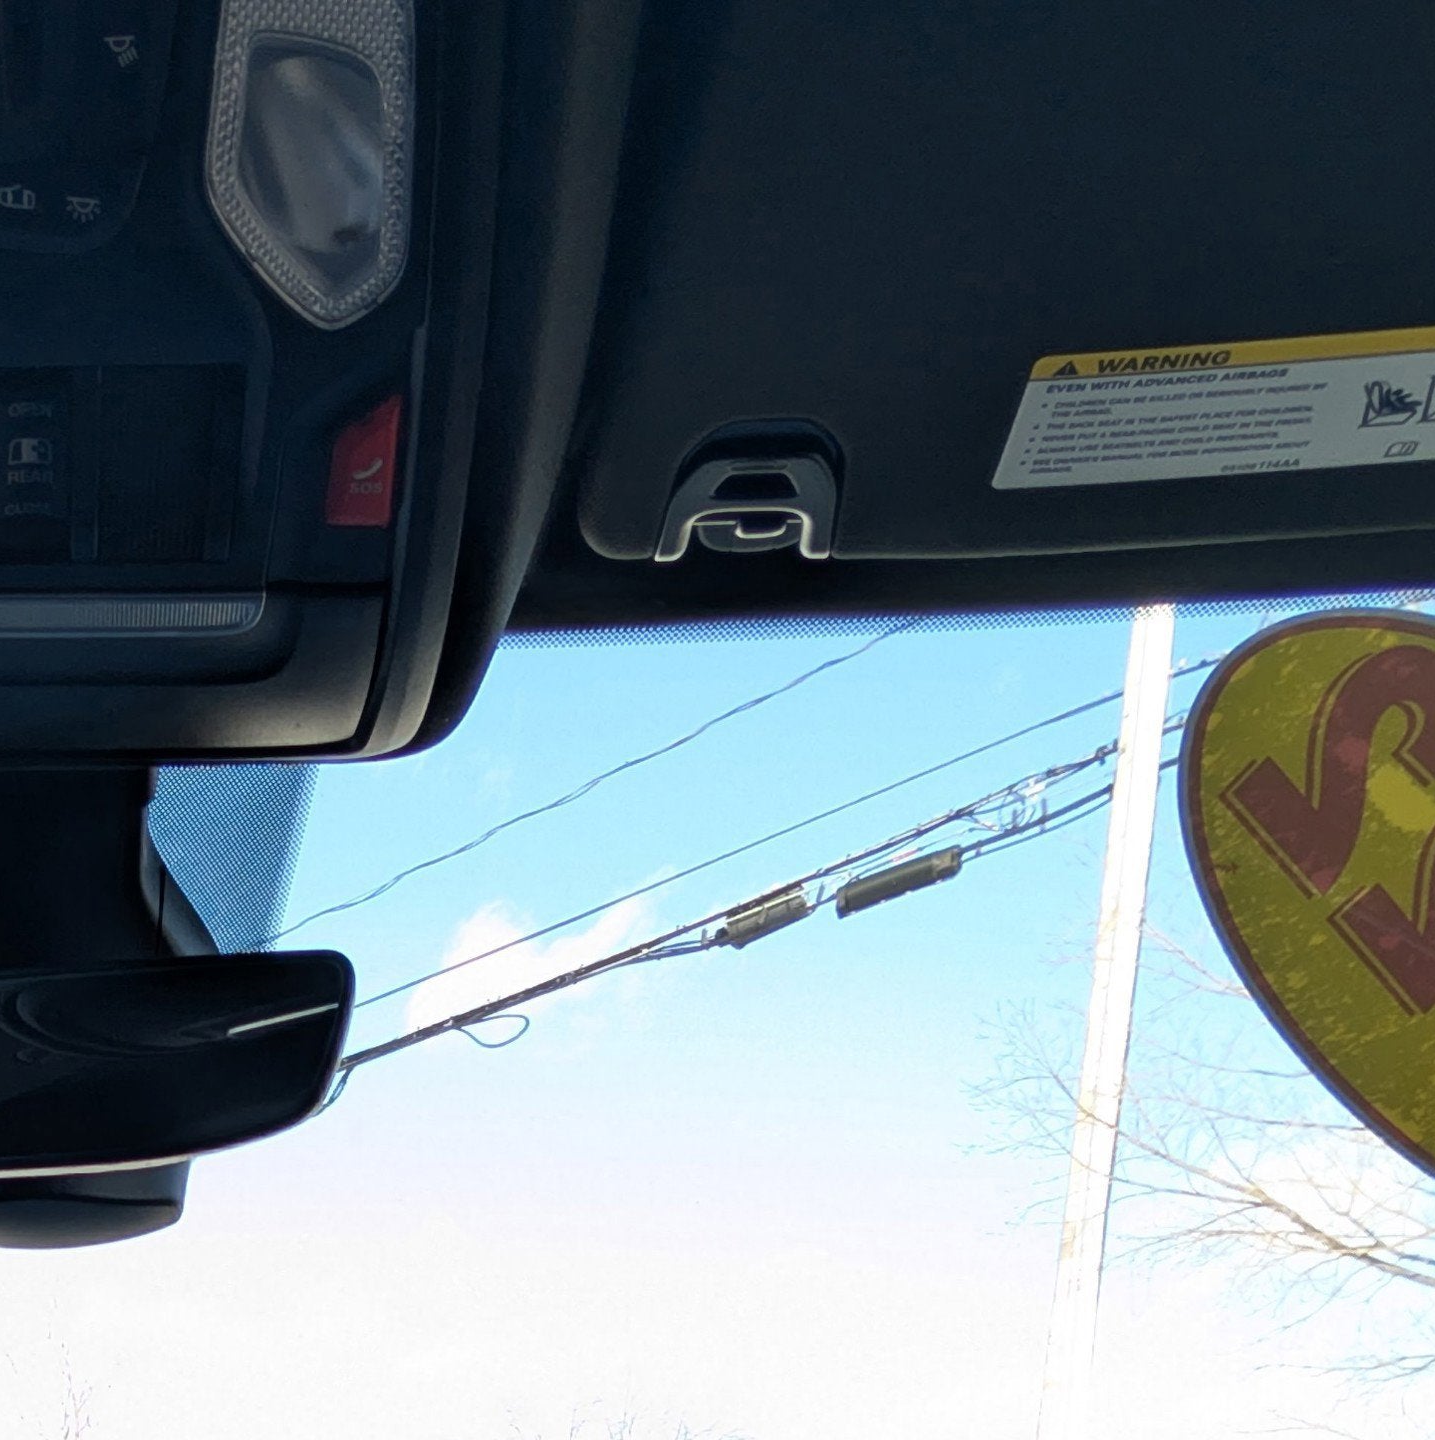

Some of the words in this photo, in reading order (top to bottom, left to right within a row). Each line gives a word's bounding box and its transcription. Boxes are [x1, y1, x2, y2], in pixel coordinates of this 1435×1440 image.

[1097, 350, 1233, 374] WARNING
[1047, 383, 1087, 394] EVEN
[1091, 380, 1131, 391] WITH
[1133, 374, 1217, 388] ADVANCED
[1220, 368, 1290, 382] AIRBAGS
[349, 481, 383, 494] SOS
